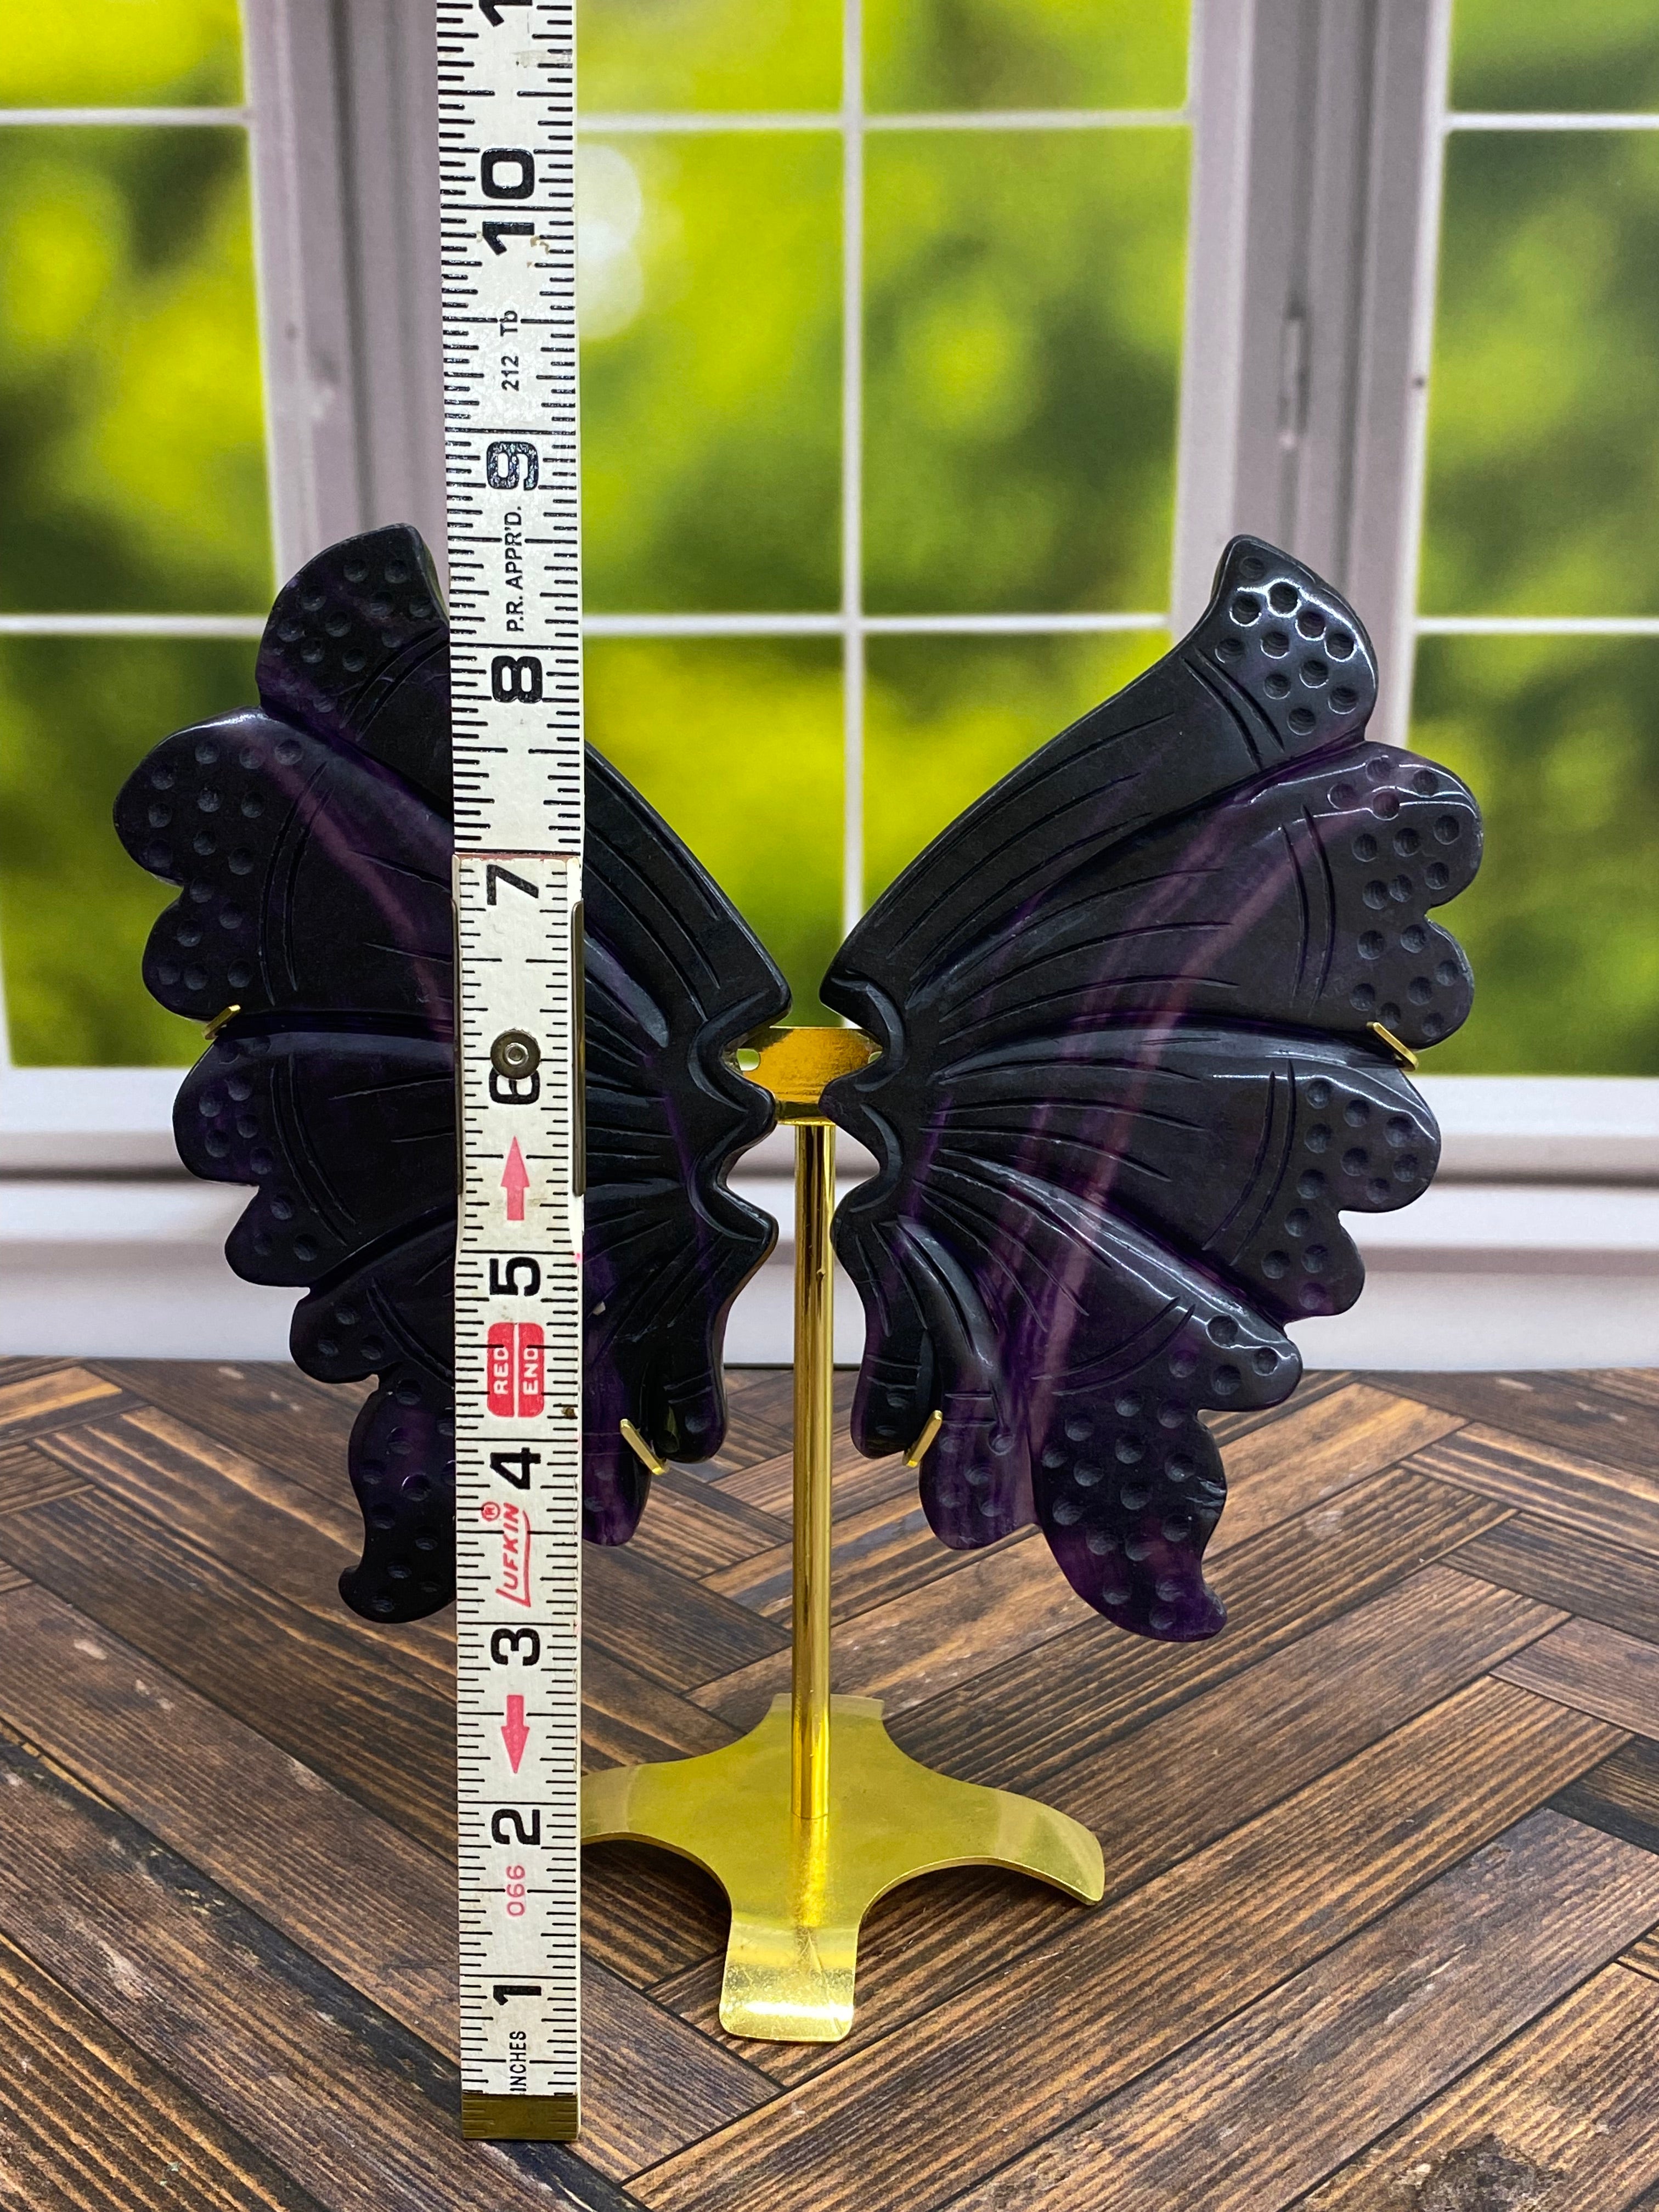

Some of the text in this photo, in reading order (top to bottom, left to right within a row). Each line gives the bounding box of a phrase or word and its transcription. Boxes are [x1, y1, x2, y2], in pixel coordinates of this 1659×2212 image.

[481, 148, 535, 256] 10
[501, 356, 520, 391] 212
[486, 442, 539, 491] 9
[505, 506, 524, 631] P.R. APPR'D.
[491, 656, 543, 703] 8
[486, 865, 539, 906] 7
[489, 1256, 540, 1296] 5
[494, 1347, 509, 1395] RED
[523, 1347, 539, 1395] END
[490, 1447, 541, 1490] 4
[490, 1627, 540, 1666] 3
[491, 1808, 540, 1846] 2
[506, 1865, 526, 1917] 066
[493, 1985, 542, 2006] 1
[509, 2030, 527, 2092] INCHES
